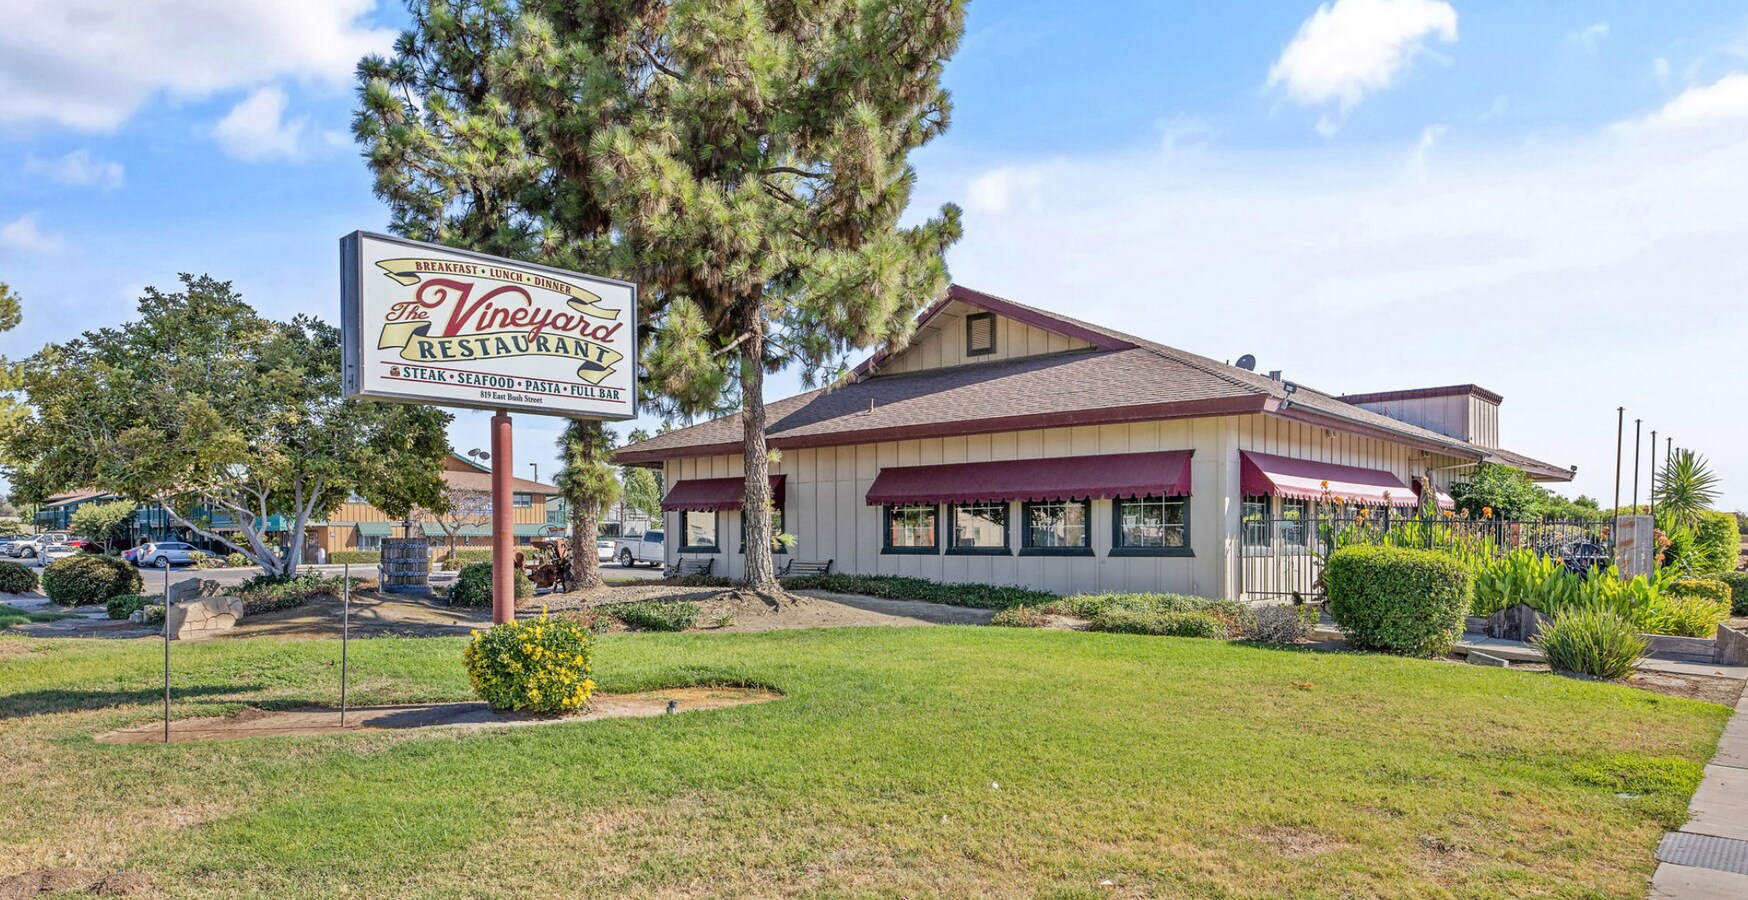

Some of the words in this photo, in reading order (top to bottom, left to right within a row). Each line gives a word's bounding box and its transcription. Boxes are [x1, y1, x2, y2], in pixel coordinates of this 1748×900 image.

[415, 261, 479, 275] BREAKFAST
[489, 268, 523, 282] LUNCH
[534, 276, 572, 295] DINNER
[385, 301, 430, 321] The
[415, 278, 623, 343] Vineyard
[417, 335, 610, 363] RESTAURANT
[403, 366, 447, 382] STEAK
[457, 372, 515, 389] SEAFOOD
[525, 380, 561, 394] PASTA
[570, 385, 596, 398] FULL
[599, 388, 620, 400] BAR
[480, 391, 491, 399] 819
[492, 391, 506, 401] East
[507, 394, 523, 402] Bush
[524, 395, 543, 404] Street
